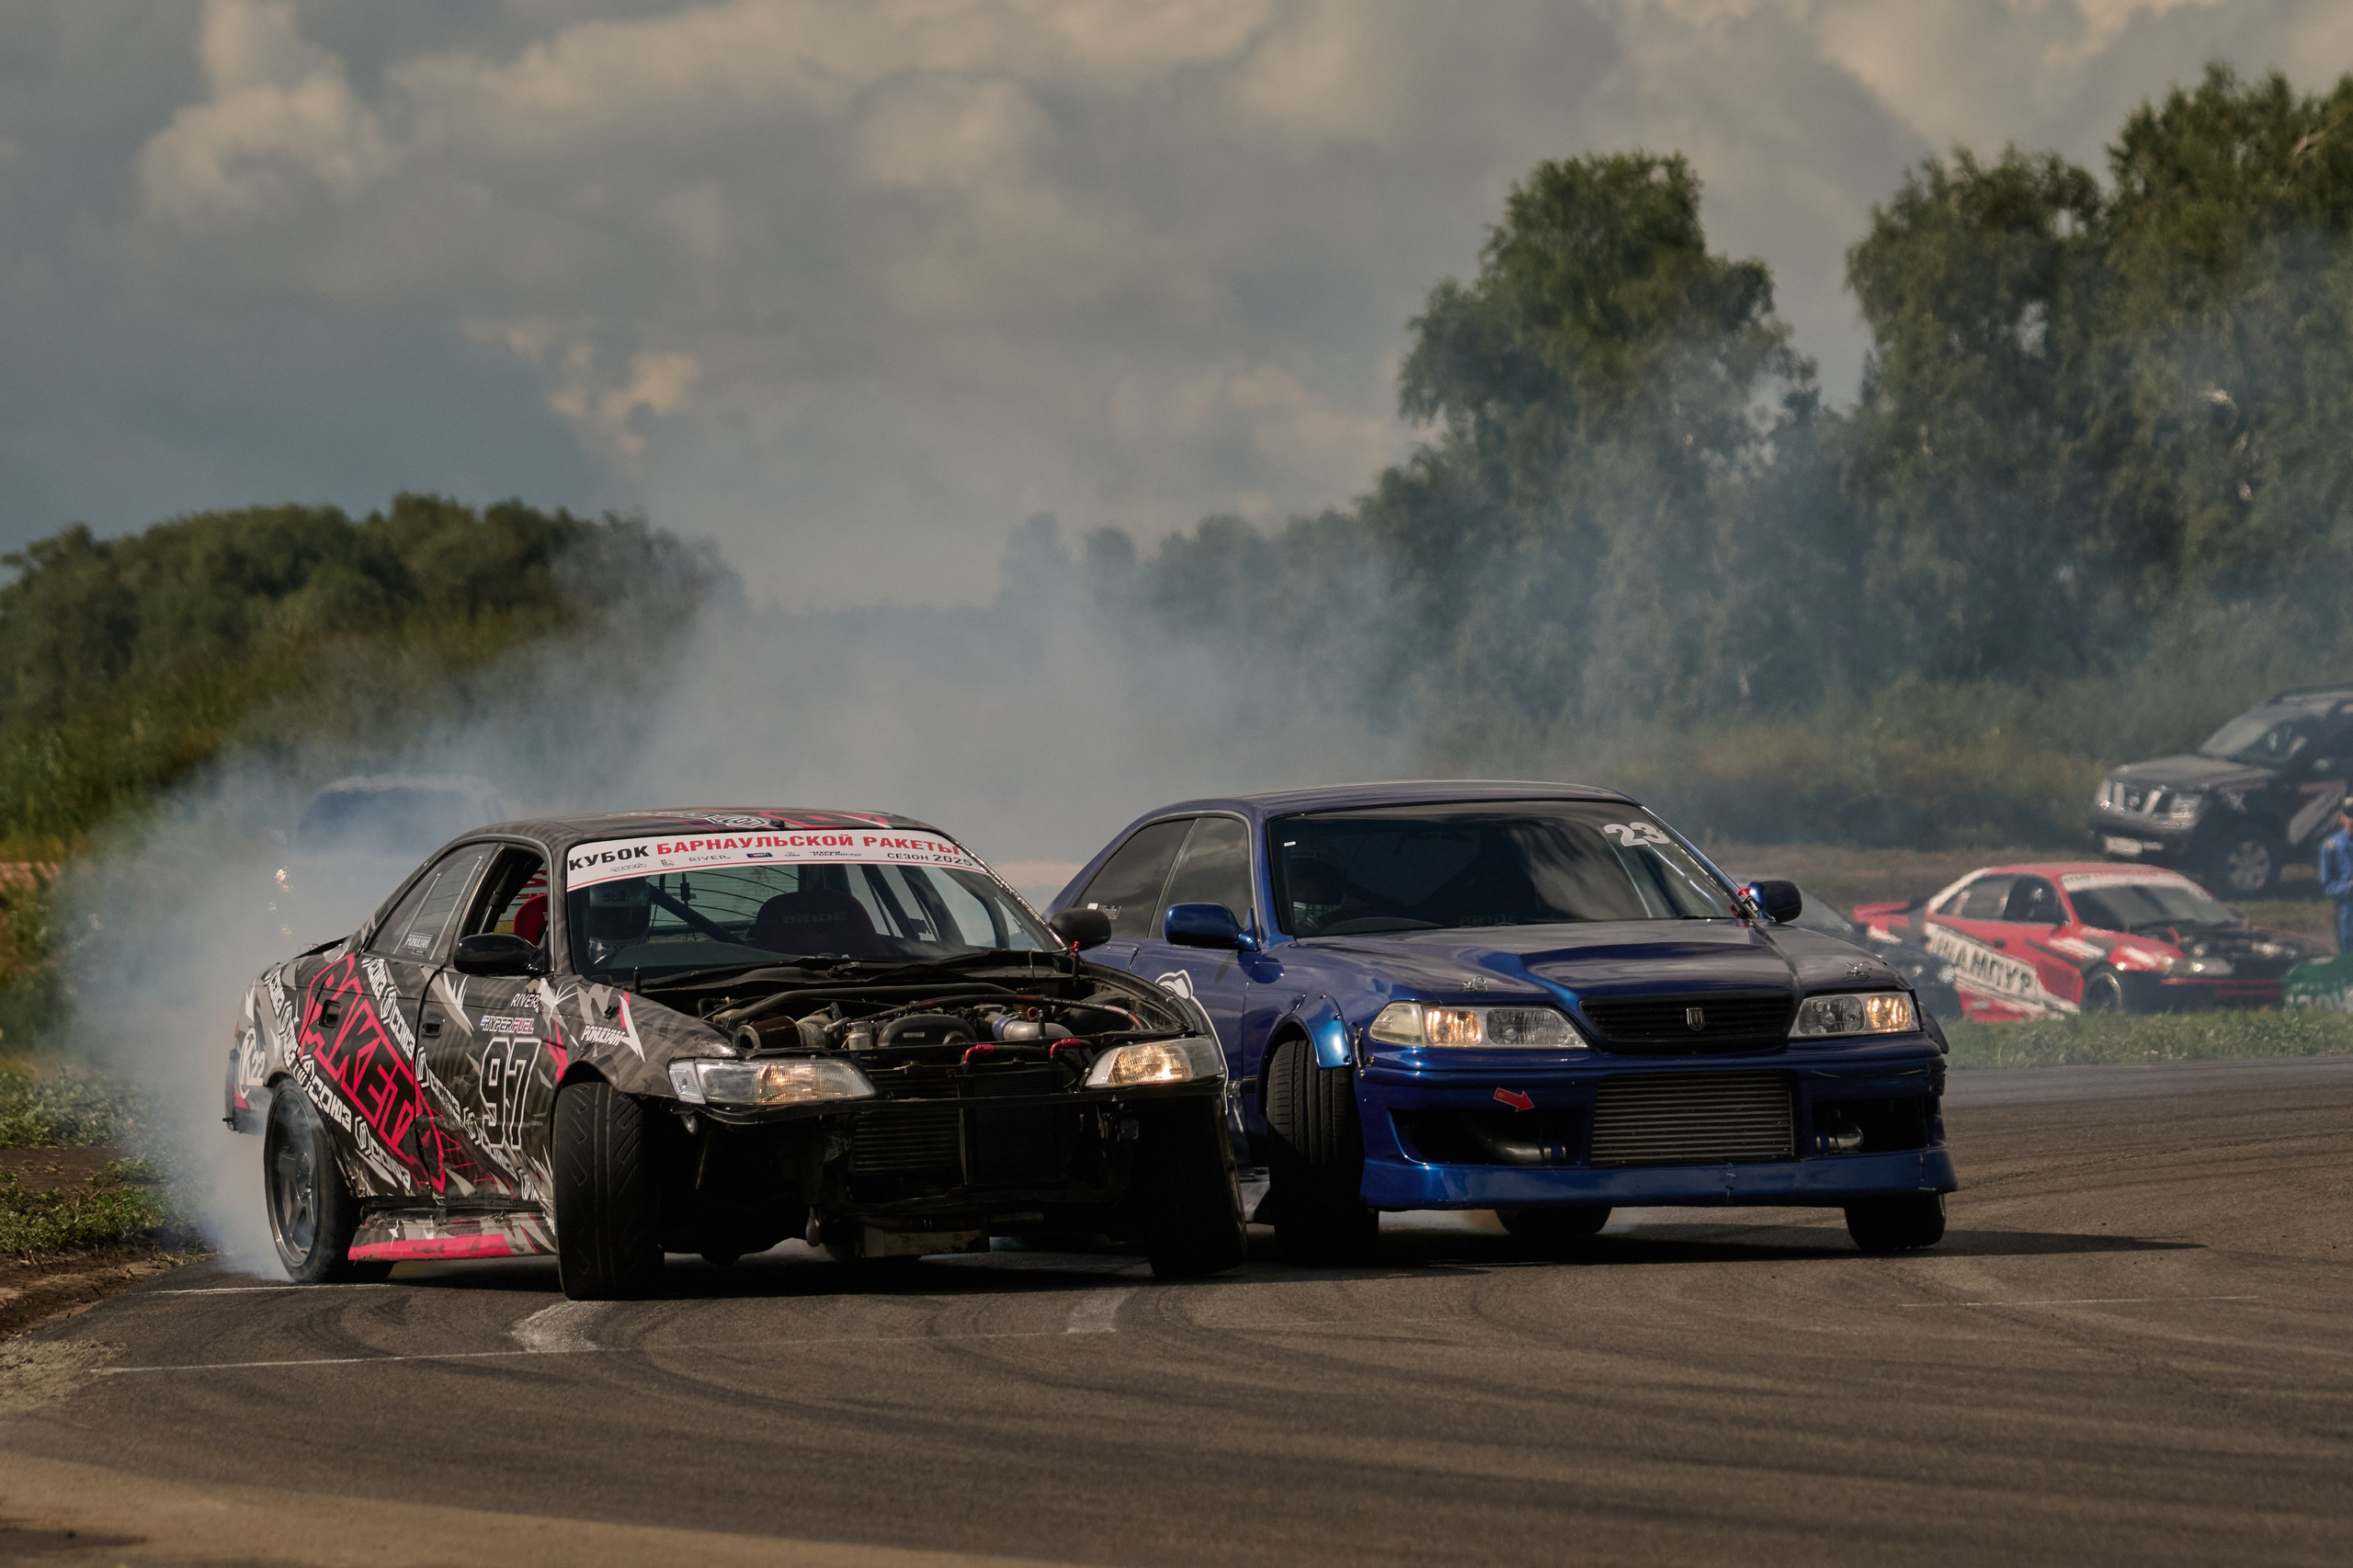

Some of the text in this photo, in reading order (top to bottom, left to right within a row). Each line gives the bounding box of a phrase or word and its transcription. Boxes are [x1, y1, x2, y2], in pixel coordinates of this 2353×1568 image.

[1604, 822, 1671, 846] 23
[568, 845, 650, 871] КУБОК
[656, 833, 854, 855] БАРНАУЛЬСКОЙ
[863, 835, 961, 855] РАКЕТЫ
[688, 855, 731, 863] RIVER
[887, 852, 973, 867] СЕЗОН 2025
[510, 993, 541, 1014] RIVER
[480, 1038, 541, 1150] 97
